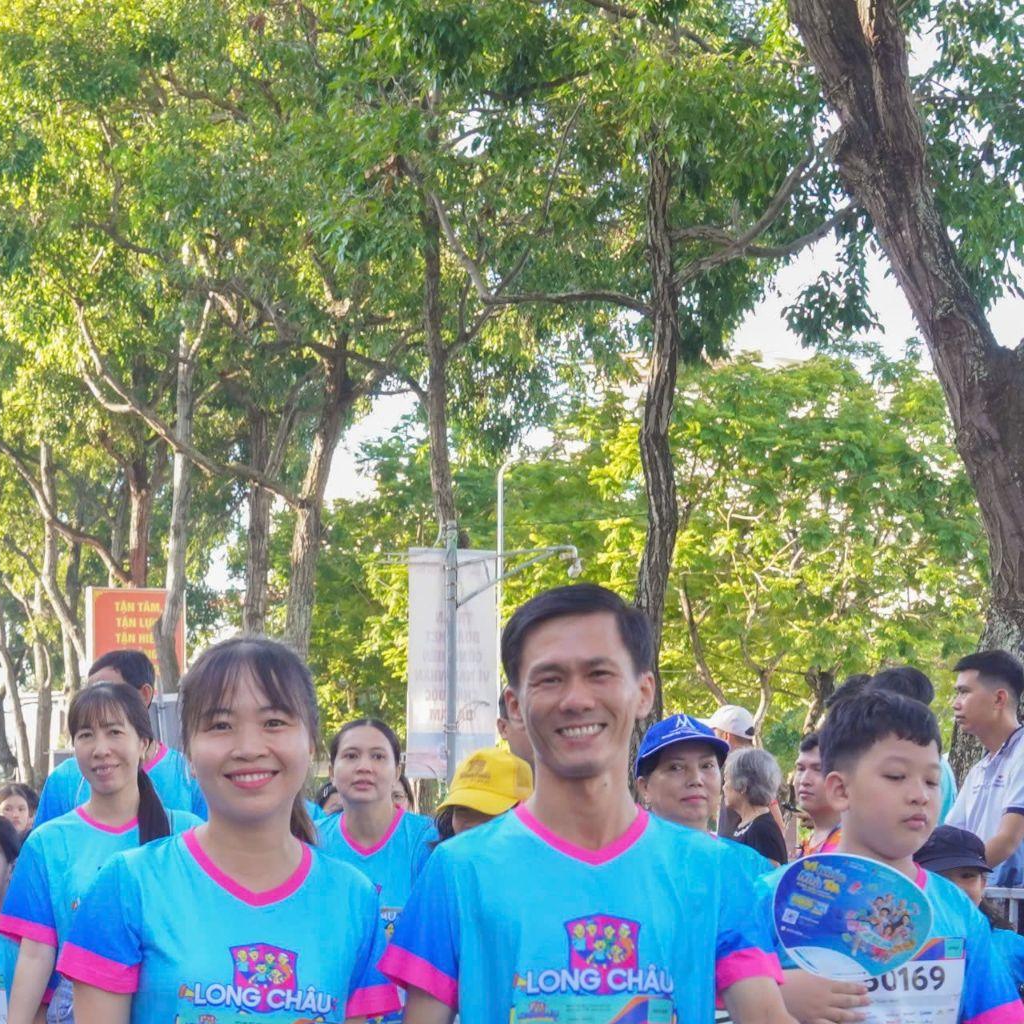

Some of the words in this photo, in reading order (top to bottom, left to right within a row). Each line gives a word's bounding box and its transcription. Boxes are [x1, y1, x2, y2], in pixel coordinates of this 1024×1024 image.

[139, 616, 157, 630] LỰ
[527, 969, 601, 994] LONG
[607, 964, 674, 993] CHÂU
[194, 983, 261, 1007] LONG
[267, 986, 331, 1013] CHÂU
